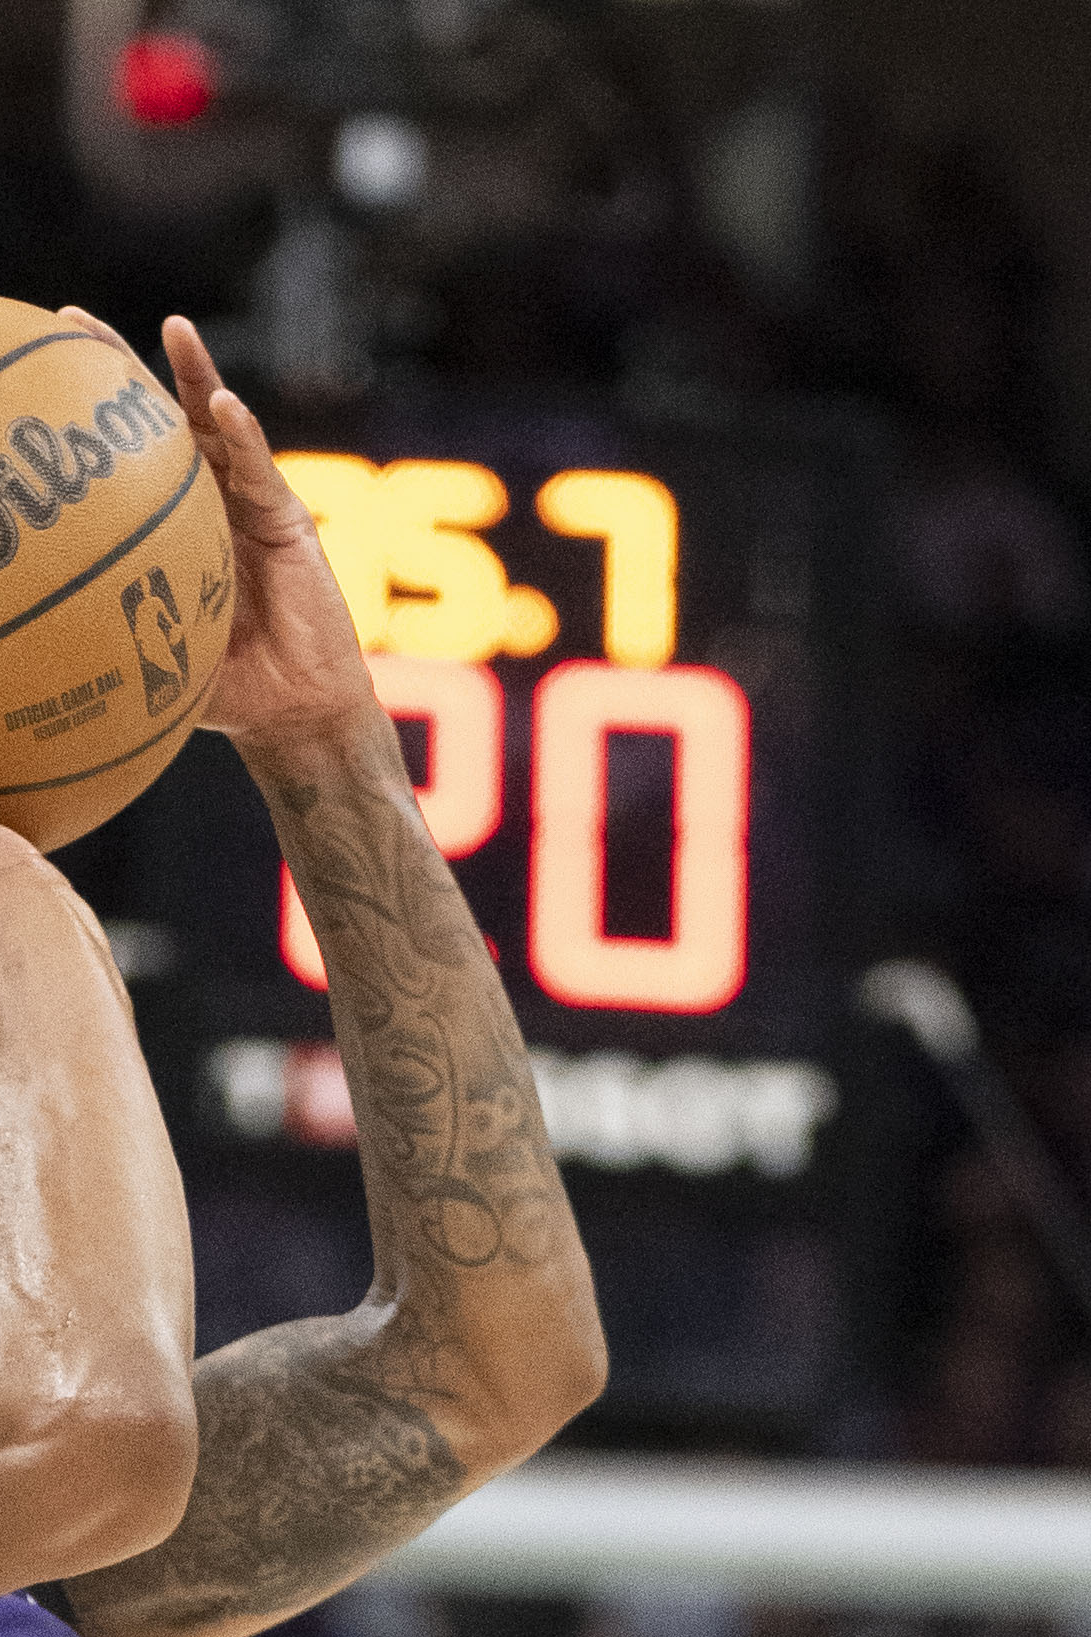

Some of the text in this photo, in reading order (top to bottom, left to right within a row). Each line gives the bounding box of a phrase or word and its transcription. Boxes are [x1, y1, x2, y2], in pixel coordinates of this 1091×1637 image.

[4, 695, 62, 732] OFFICIAL
[60, 680, 96, 712] GAME
[95, 665, 124, 696] BALL
